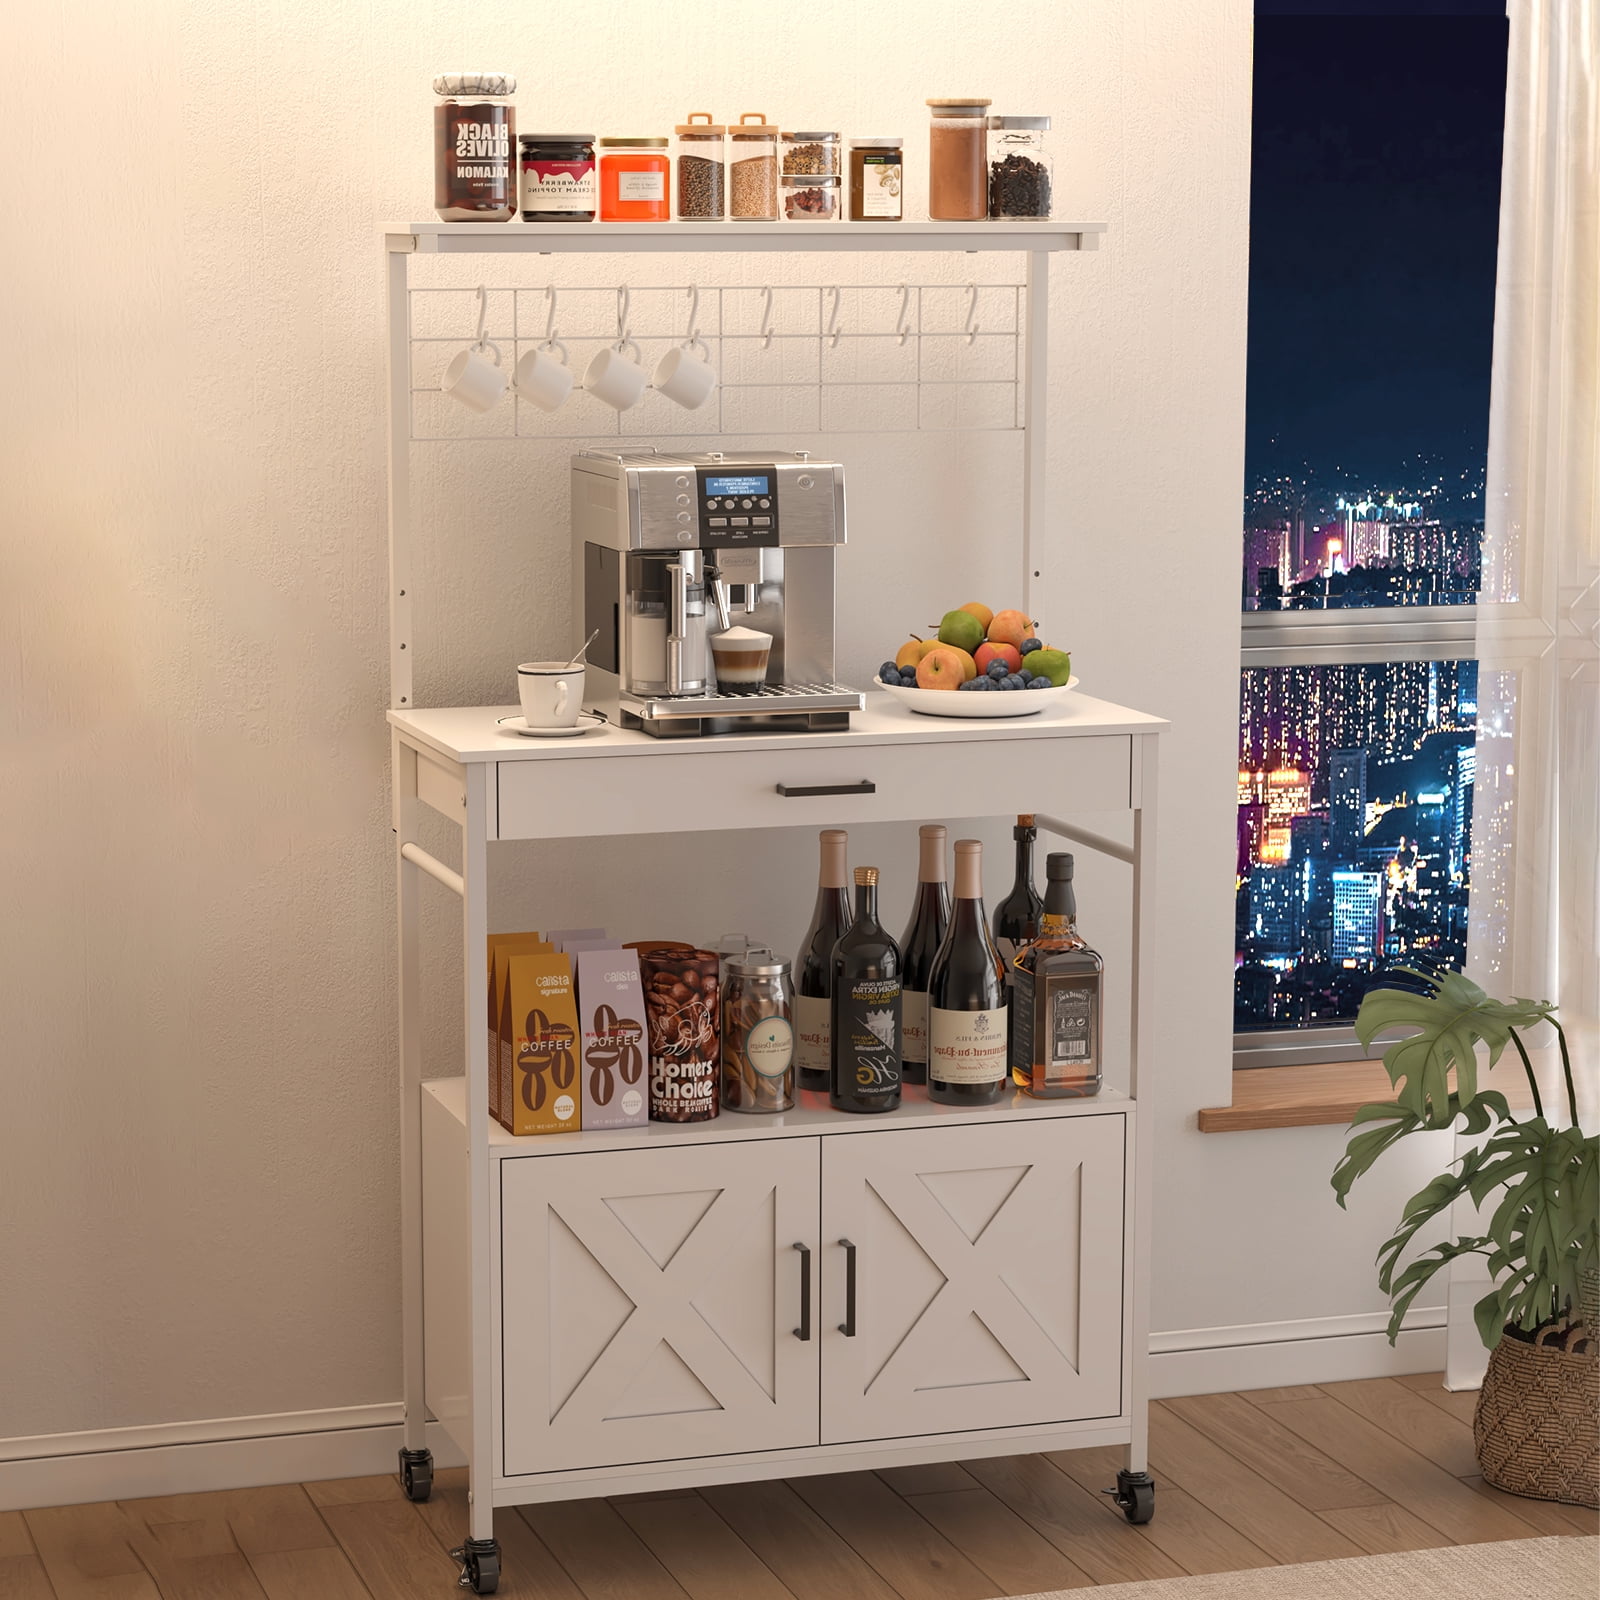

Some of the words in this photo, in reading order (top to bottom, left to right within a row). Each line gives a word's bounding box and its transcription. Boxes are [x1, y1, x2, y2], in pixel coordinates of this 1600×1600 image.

[521, 1040, 571, 1052] COFFEE
[590, 1034, 640, 1048] COFFEE
[652, 1056, 713, 1078] Homers
[651, 1076, 713, 1099] Choice
[652, 1098, 678, 1107] WHOLE
[652, 1105, 678, 1113] DARK
